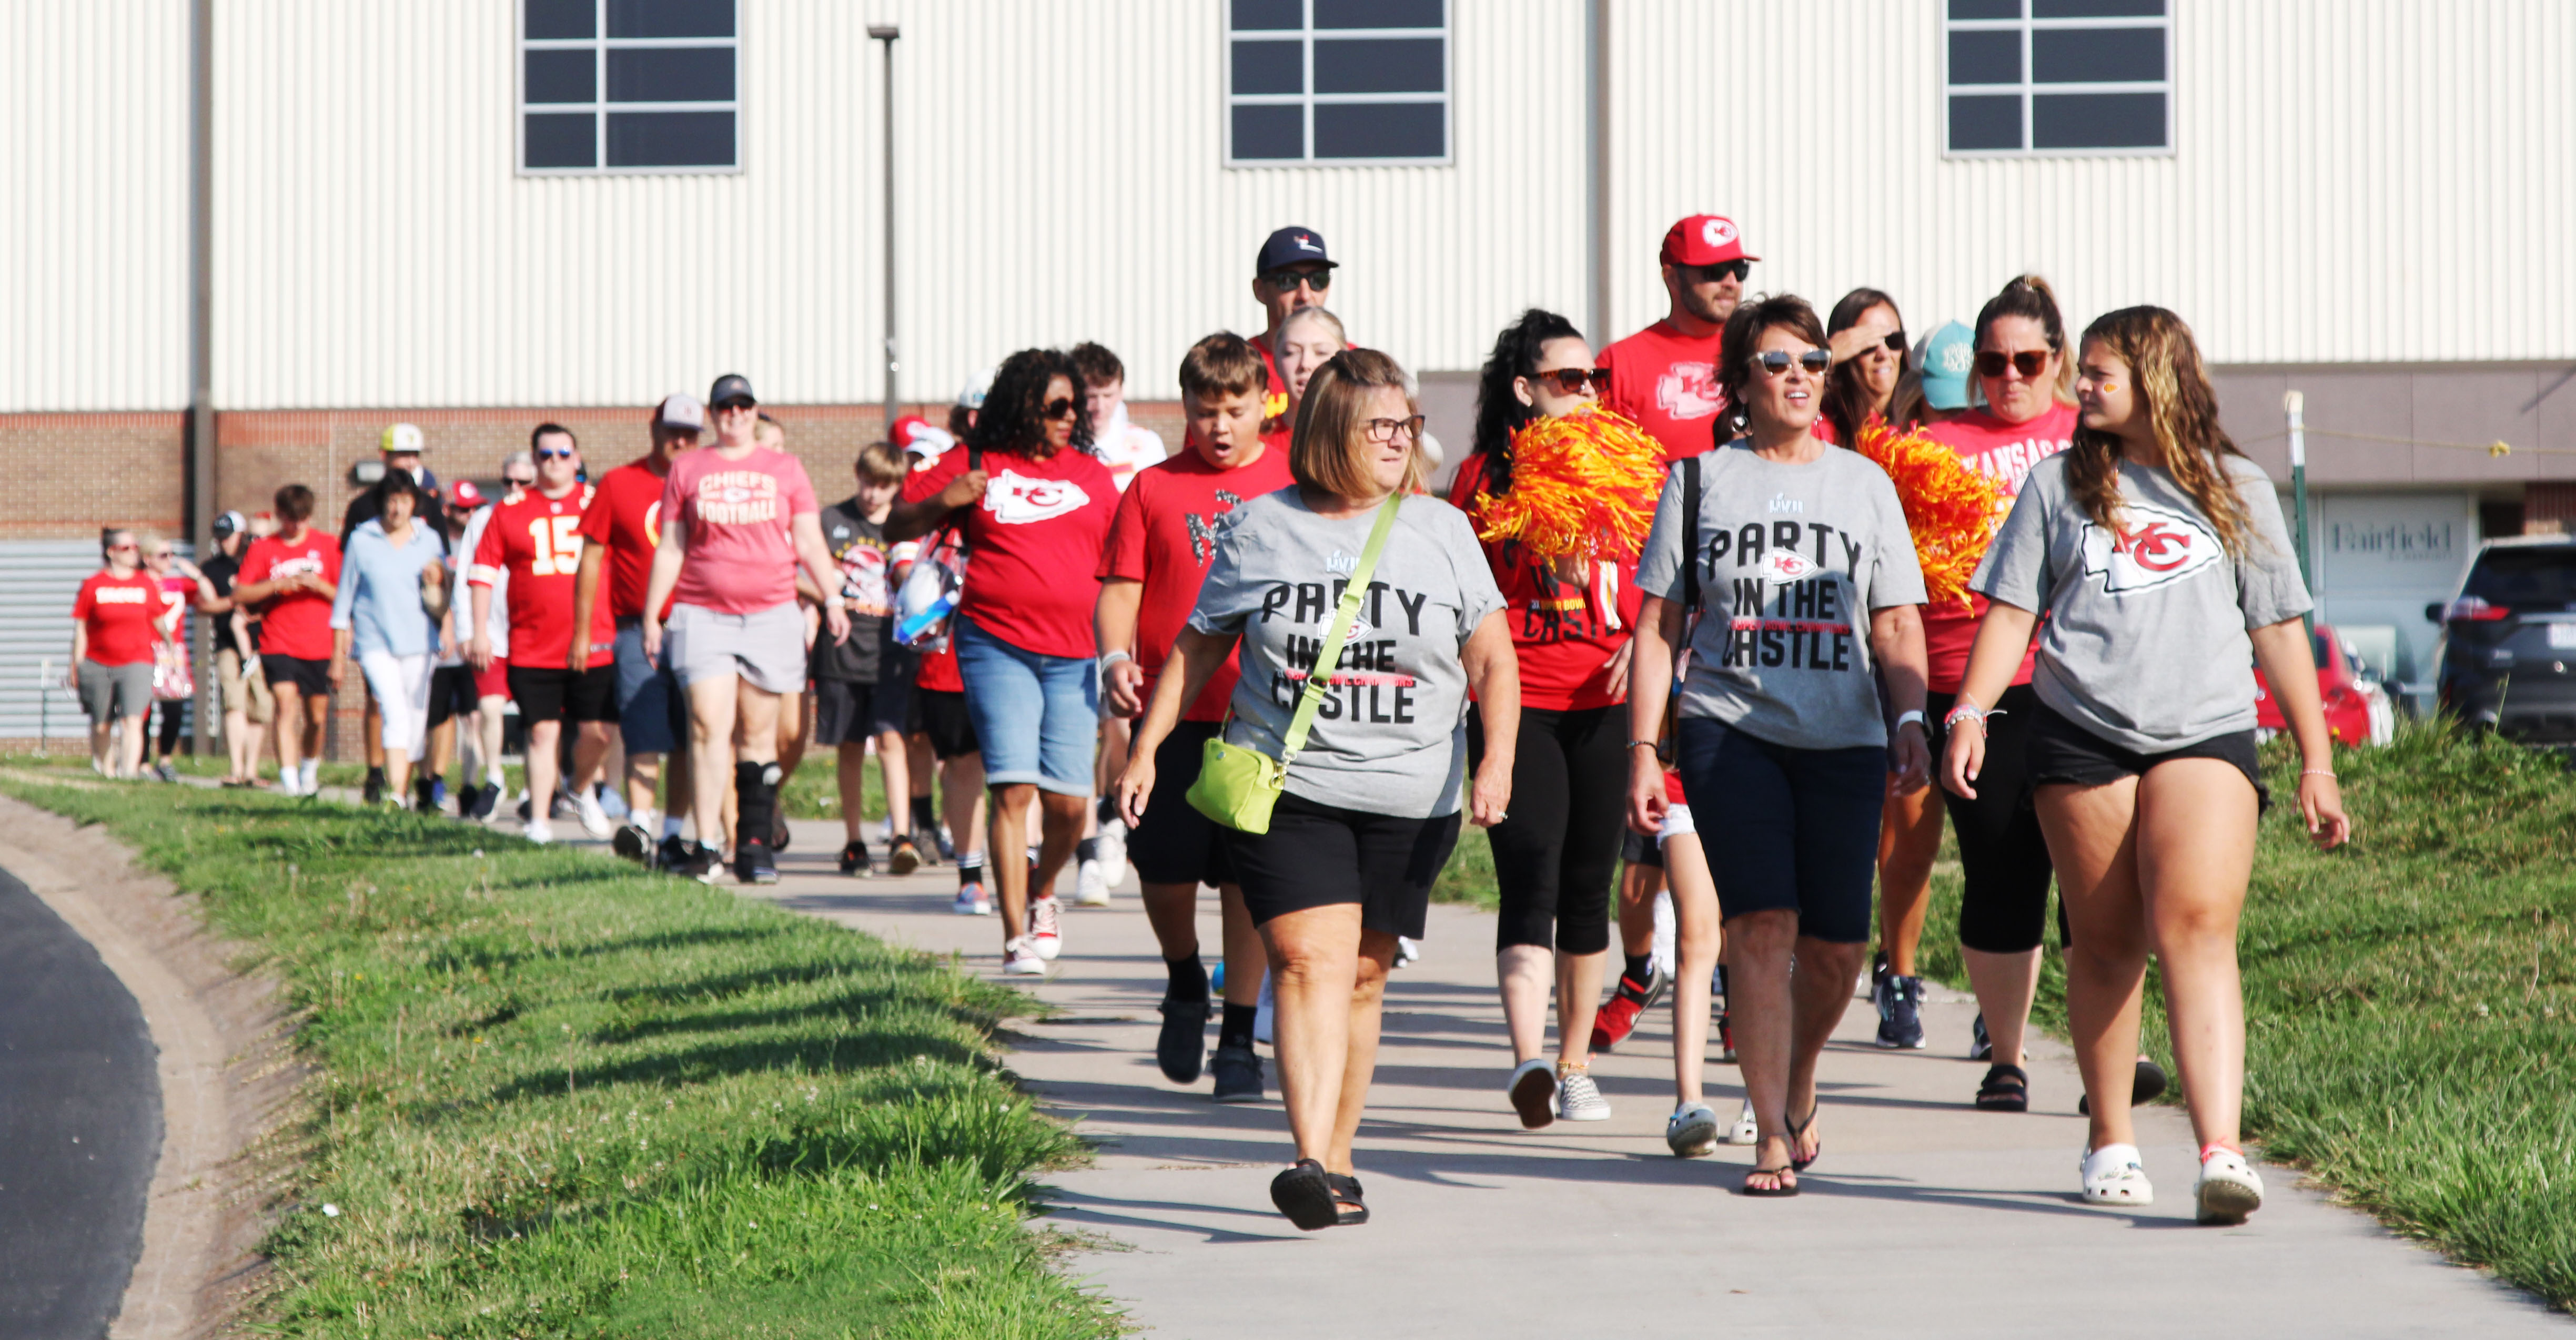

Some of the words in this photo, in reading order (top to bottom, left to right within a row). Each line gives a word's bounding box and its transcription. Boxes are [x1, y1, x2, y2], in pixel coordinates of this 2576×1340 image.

[699, 470, 777, 497] CHIEFS
[696, 499, 777, 525] FOOTBALL
[529, 515, 584, 576] 15
[1708, 520, 1863, 584] PARTY
[2112, 522, 2191, 572] KC
[2332, 521, 2451, 551] Fairfield
[1733, 578, 1764, 617] IN
[1774, 580, 1838, 620] THE
[1730, 620, 1762, 631] SUPER
[1764, 620, 1794, 631] BOWL
[1795, 622, 1851, 635] CHAMPIONS
[1287, 634, 1320, 671] IN
[1325, 674, 1352, 686] OWL
